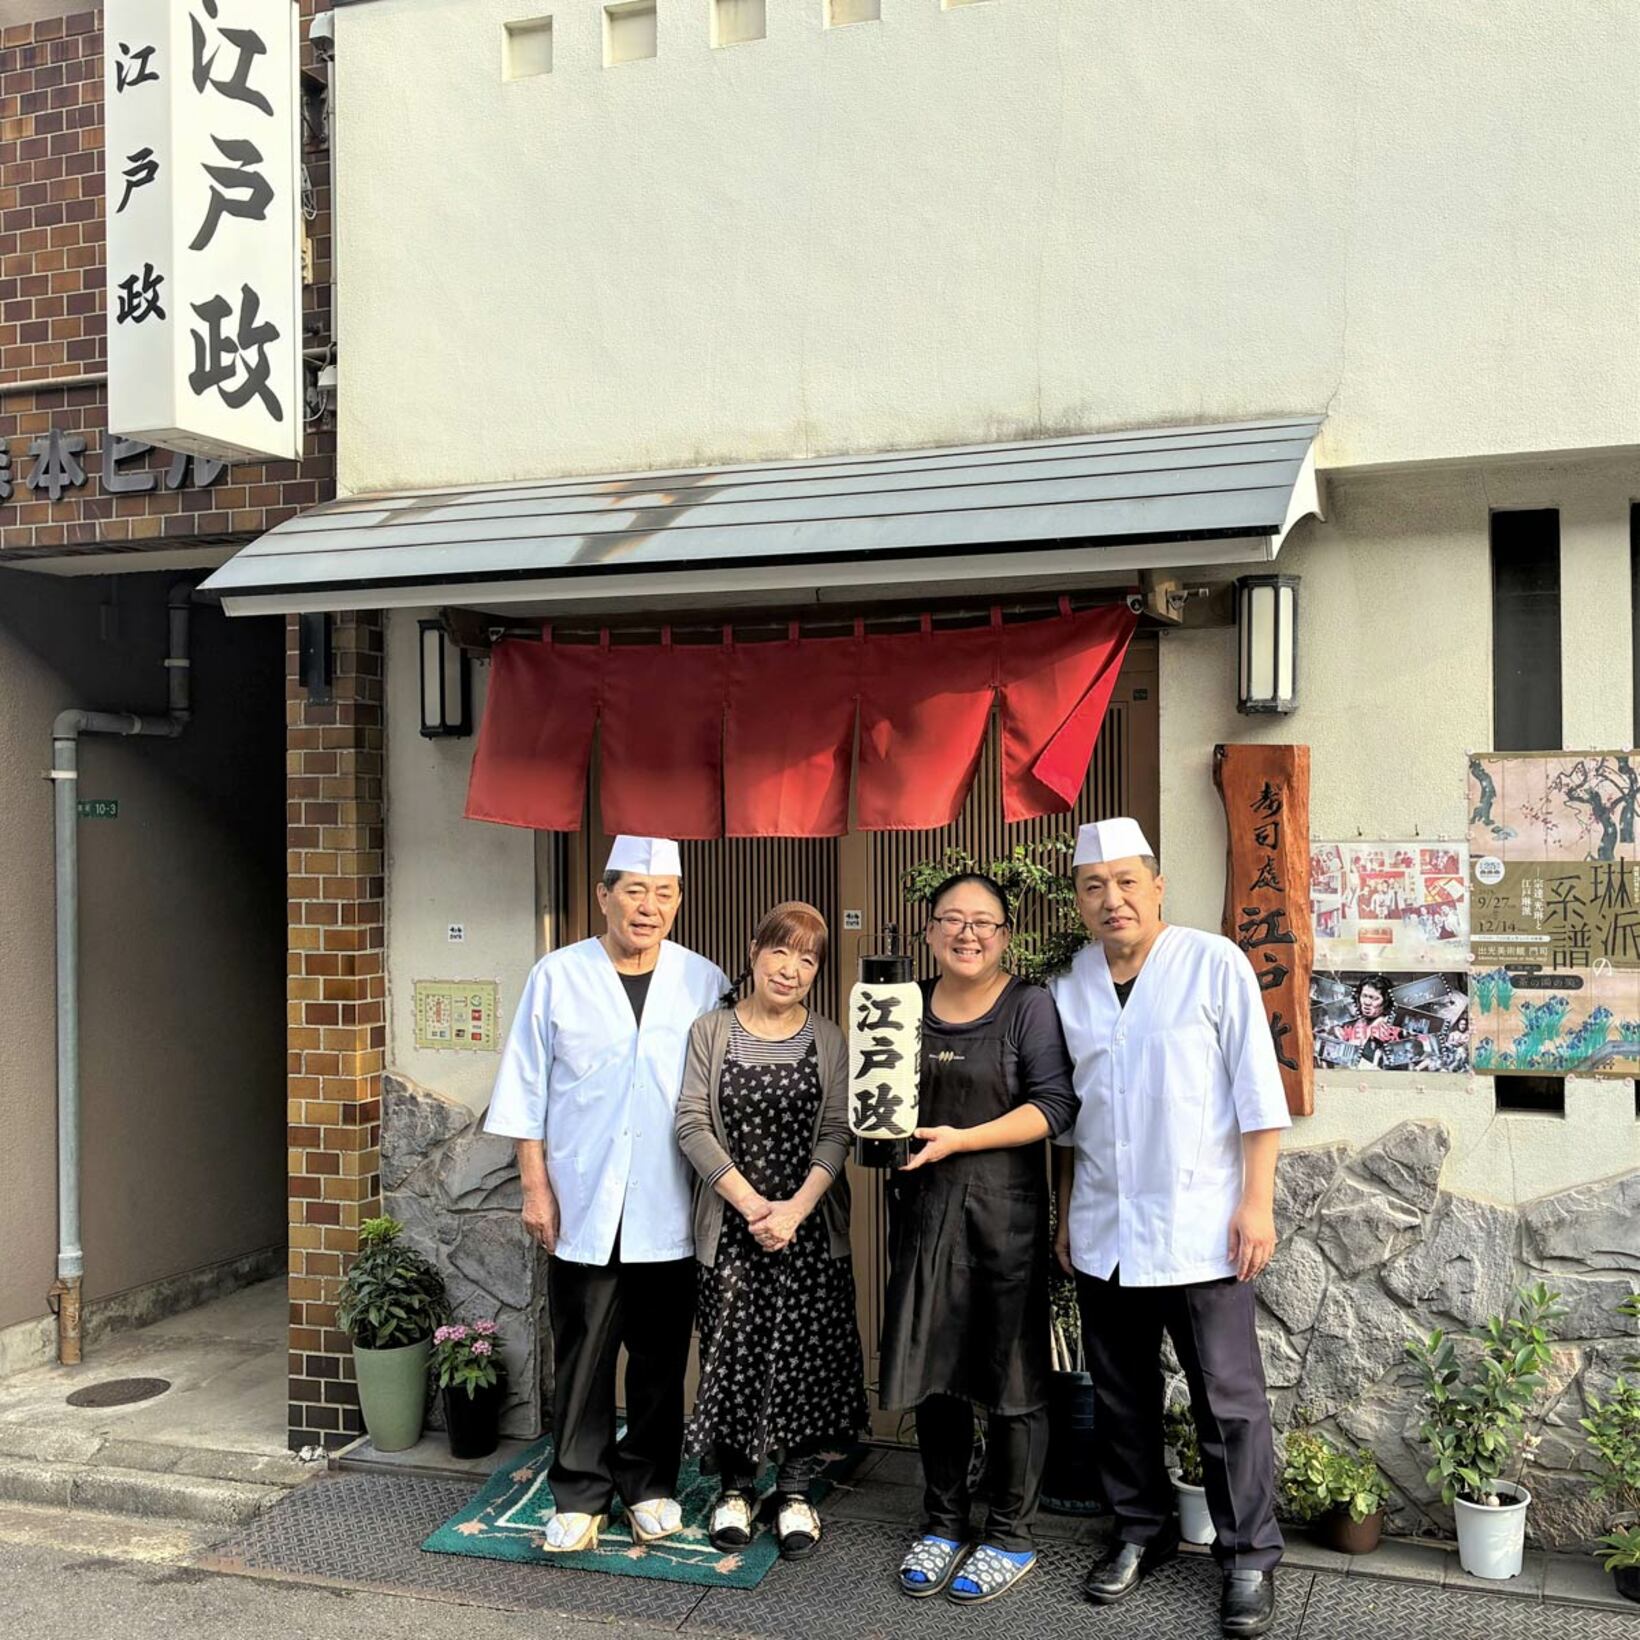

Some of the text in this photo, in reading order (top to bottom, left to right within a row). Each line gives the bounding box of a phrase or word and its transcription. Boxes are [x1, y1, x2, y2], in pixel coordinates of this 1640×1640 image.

[115, 42, 168, 325] 江戸政
[188, 0, 284, 423] 江戸政
[95, 803, 116, 815] 10-3
[1478, 896, 1510, 909] 9/27
[1478, 920, 1516, 932] 12/14
[853, 990, 907, 1136] 江戸政
